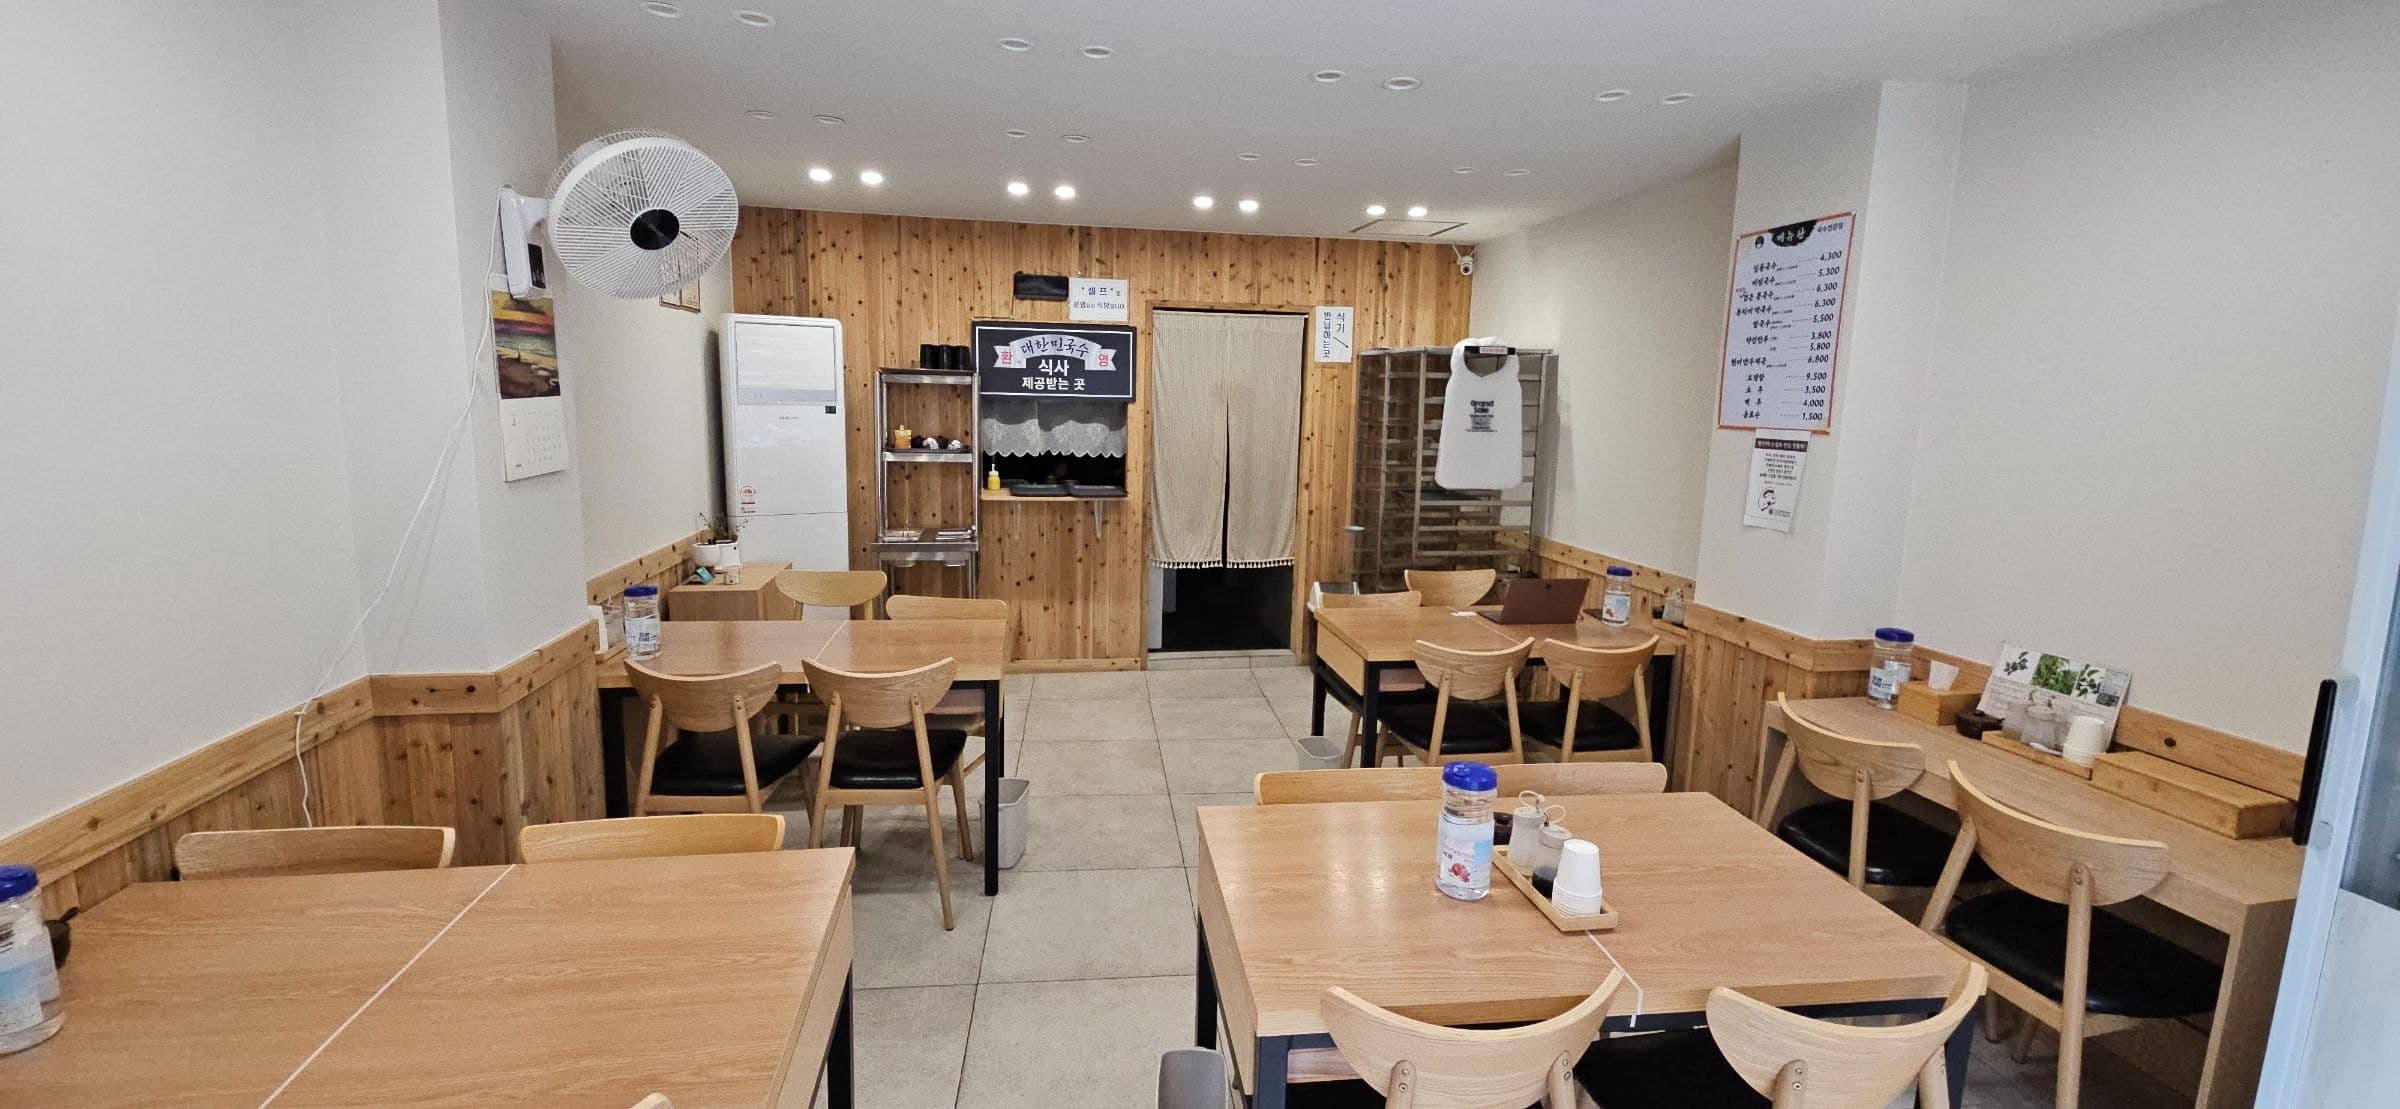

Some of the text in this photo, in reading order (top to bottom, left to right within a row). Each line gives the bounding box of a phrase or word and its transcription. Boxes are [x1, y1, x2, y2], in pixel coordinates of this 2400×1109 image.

[1820, 250, 1842, 261] 4,300
[1818, 266, 1840, 277] 5,300
[1816, 282, 1838, 293] 6,300
[1814, 298, 1836, 308] 6,300
[1335, 312, 1345, 334] 식기
[1812, 313, 1834, 323] 5,500
[1810, 330, 1832, 340] 3,800
[1020, 336, 1089, 357] 대한민국수
[1809, 342, 1831, 351] 5,800
[1807, 354, 1829, 364] 6,800
[1038, 359, 1070, 376] 식사
[1805, 372, 1828, 381] 9,500
[1021, 376, 1085, 391] 제공받는 곳
[1804, 385, 1826, 394] 3,500
[1802, 399, 1825, 408] 4,000
[1801, 412, 1823, 421] 1,500
